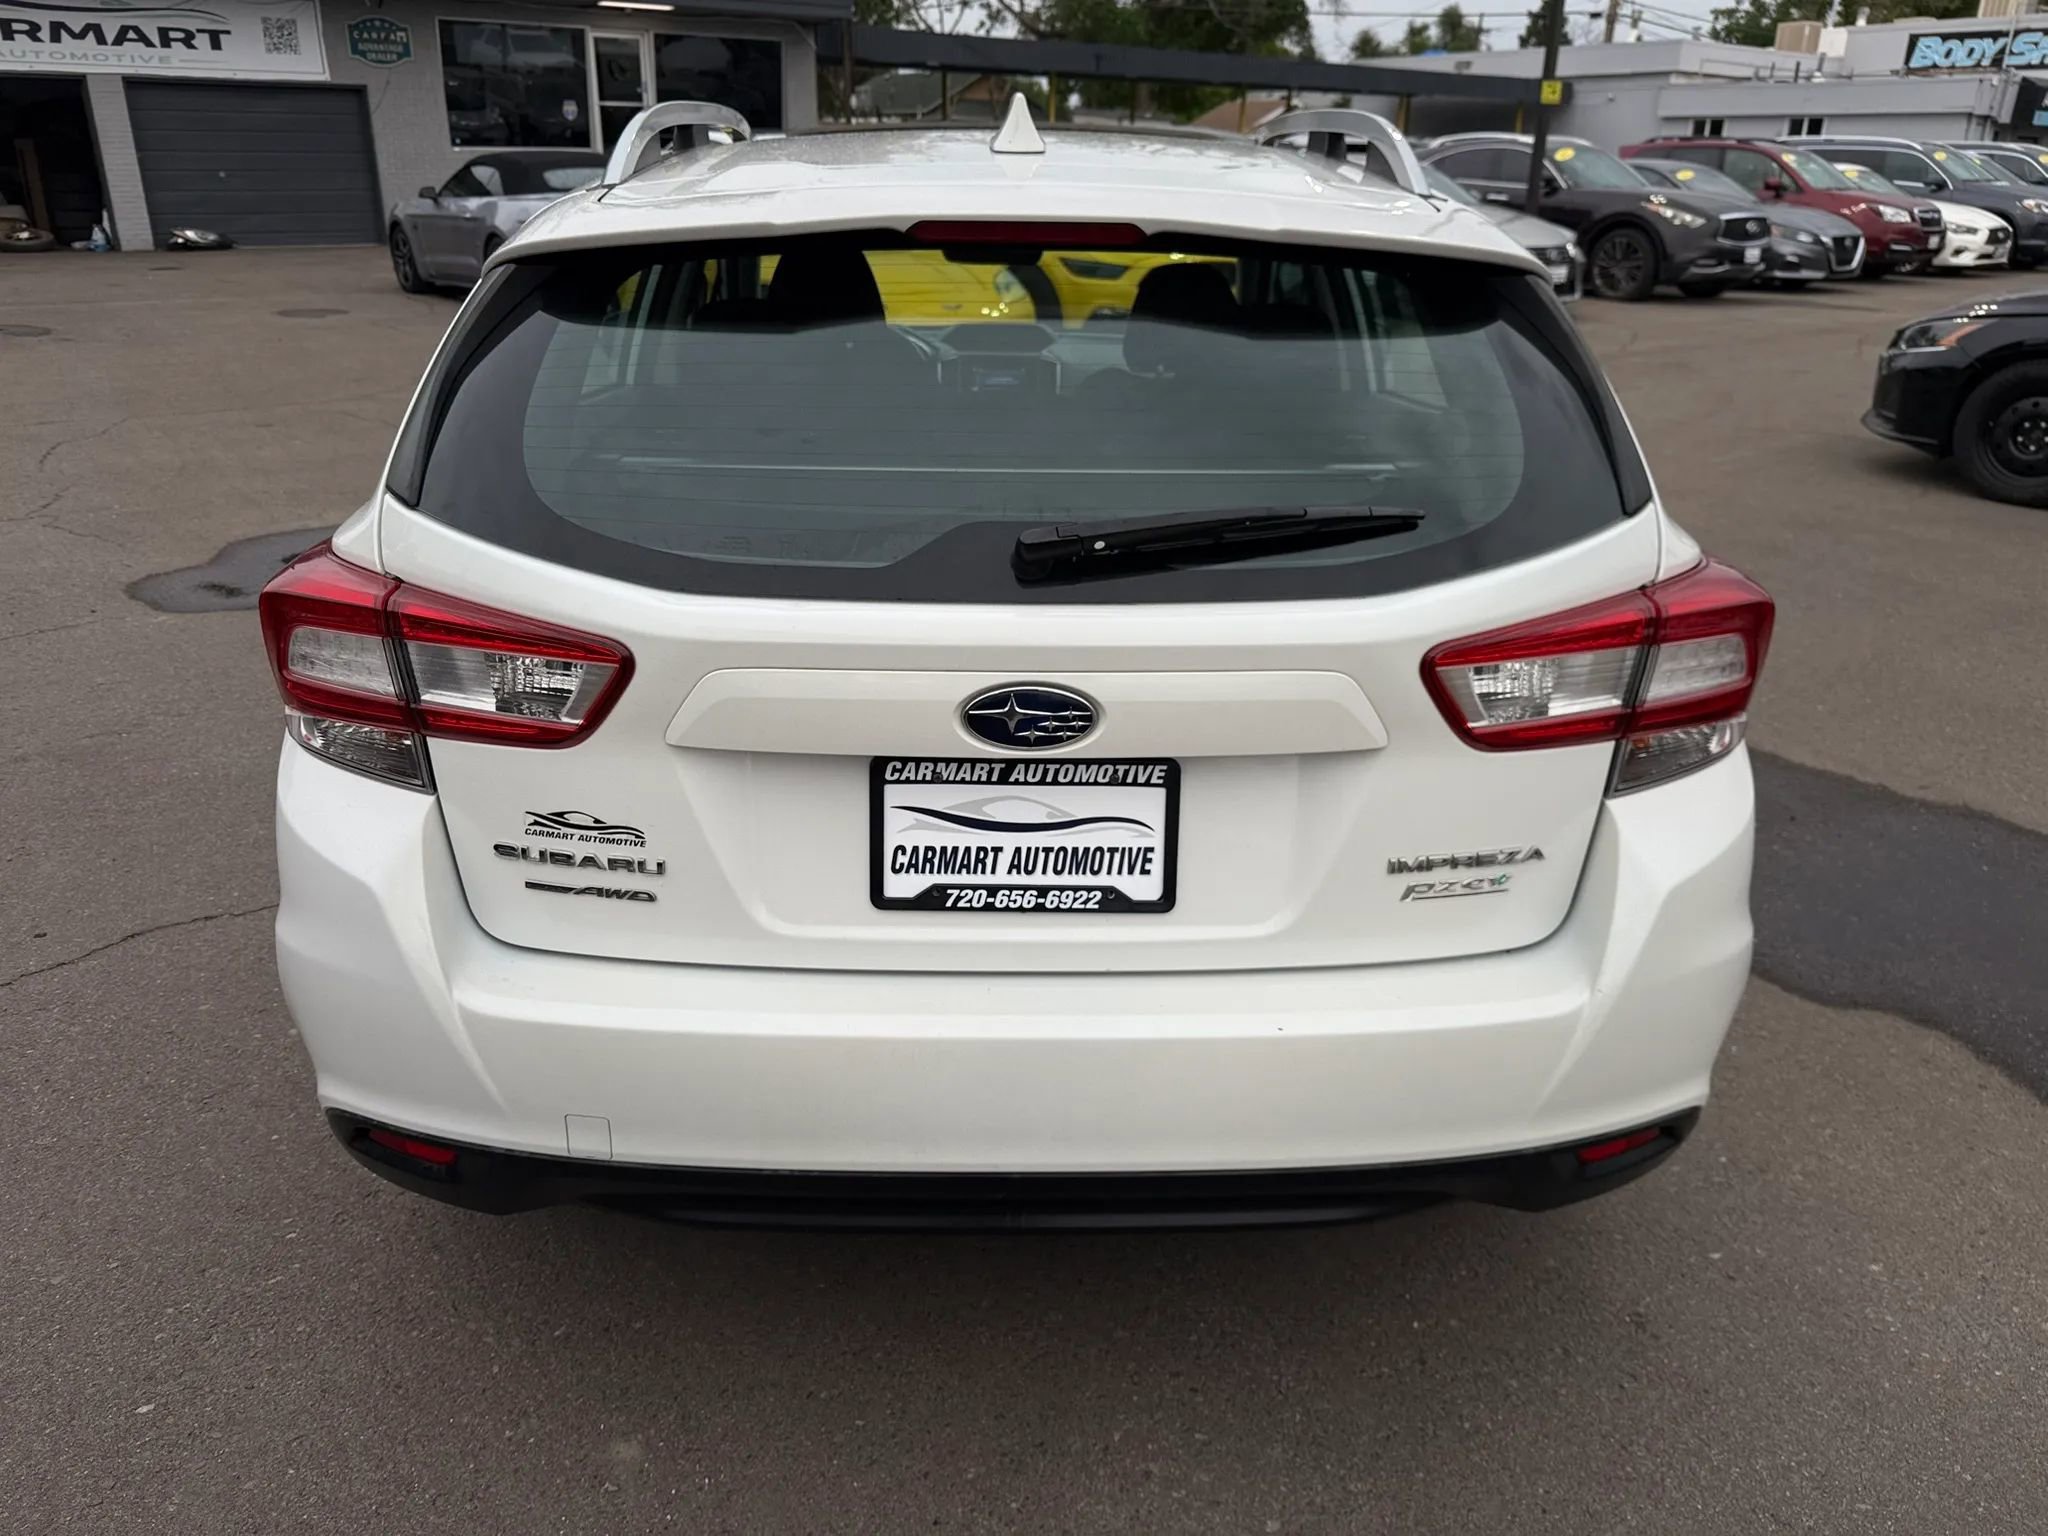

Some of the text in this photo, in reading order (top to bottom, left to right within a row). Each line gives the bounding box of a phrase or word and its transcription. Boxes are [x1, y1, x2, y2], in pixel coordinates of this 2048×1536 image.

[1908, 36, 2009, 68] BODY
[884, 761, 1168, 785] CARMART AUTOMOTIVE
[524, 827, 648, 848] CARMART AUTOMOTIVE
[493, 841, 667, 876] SUBARU
[890, 845, 1155, 877] CARMART AUTOMOTIVE
[1386, 844, 1546, 875] IMPREZA
[573, 886, 657, 902] AWD
[945, 888, 1102, 910] 720-656-6922
